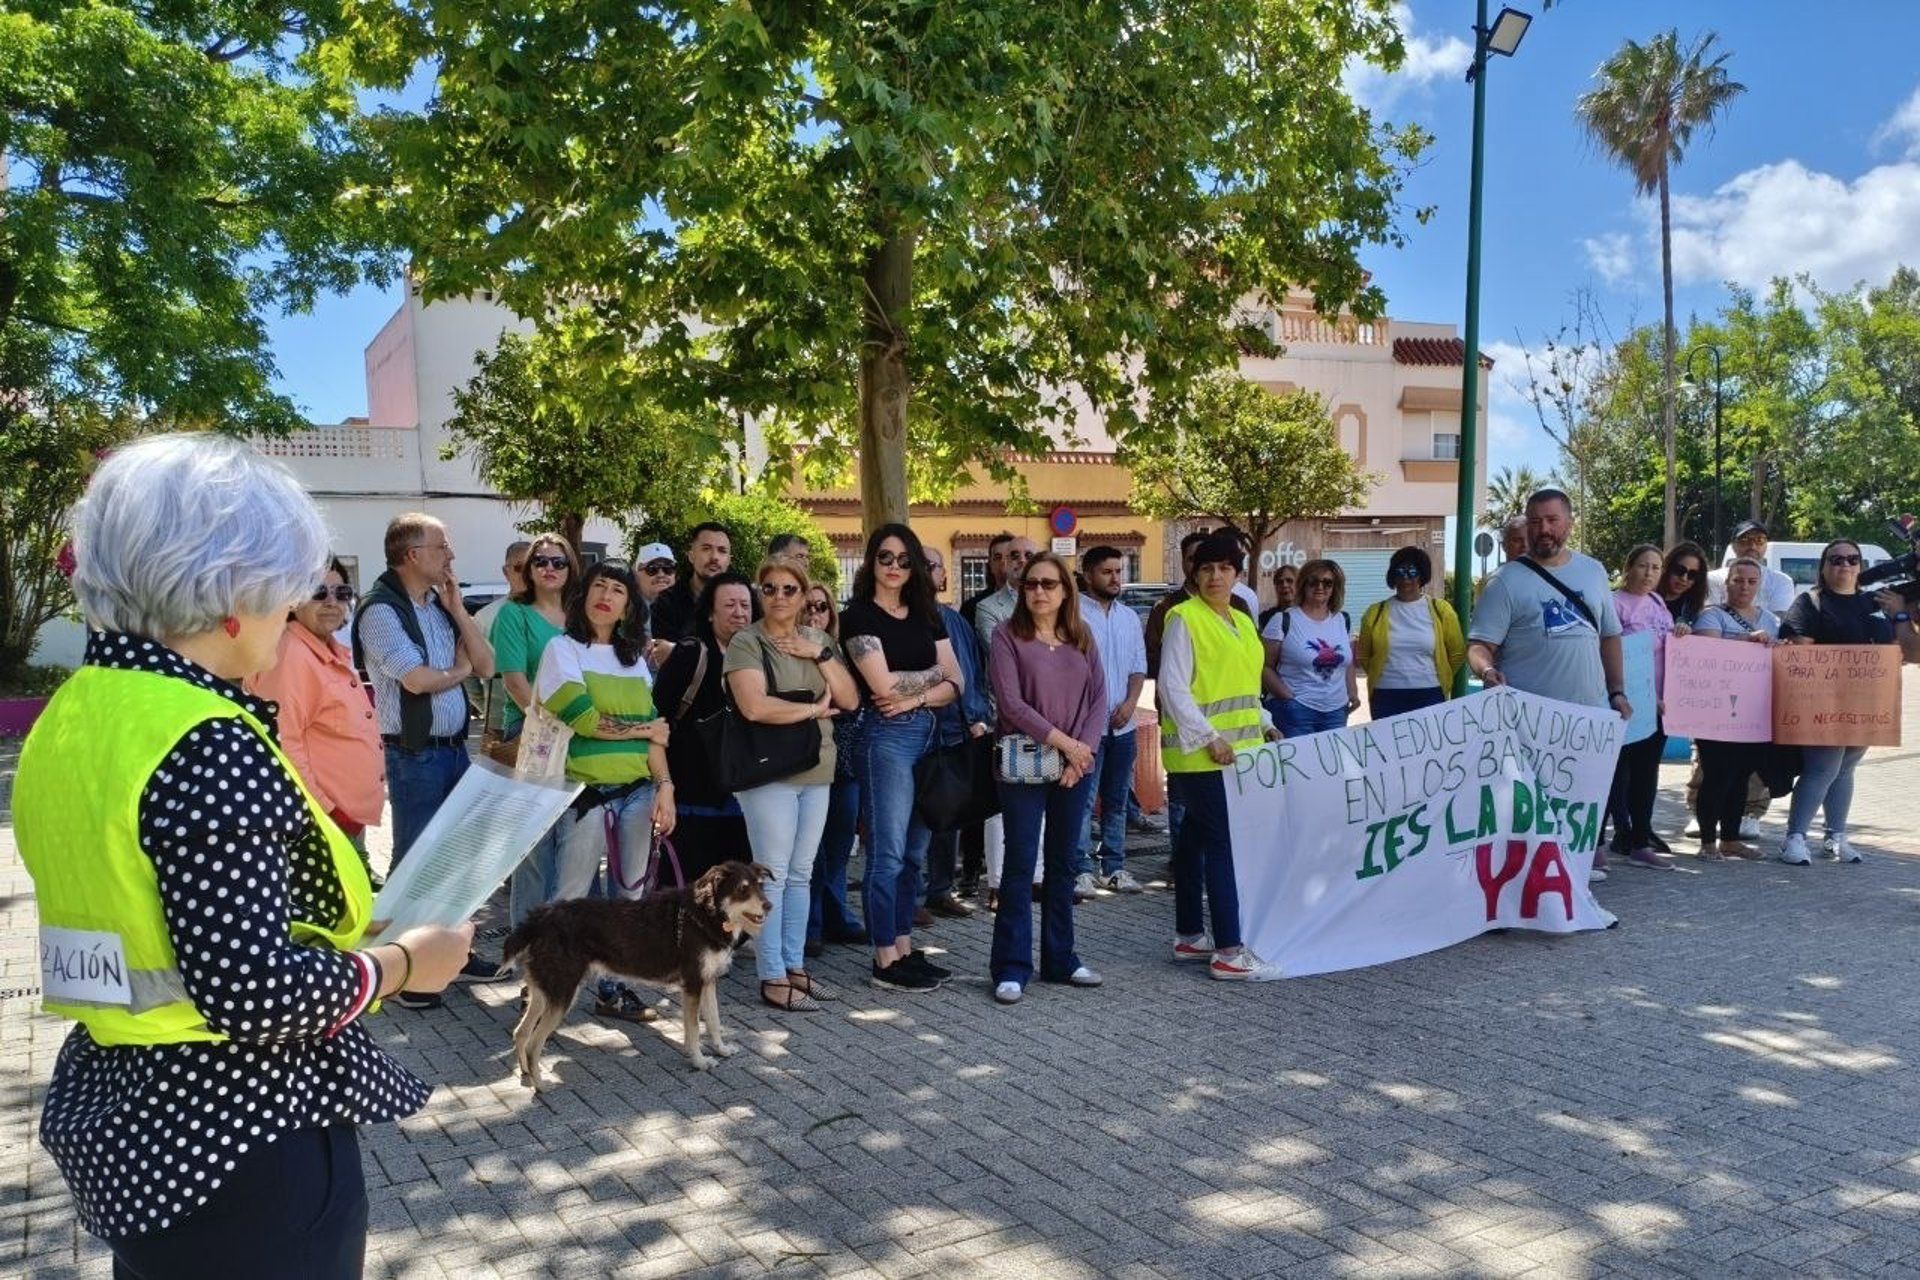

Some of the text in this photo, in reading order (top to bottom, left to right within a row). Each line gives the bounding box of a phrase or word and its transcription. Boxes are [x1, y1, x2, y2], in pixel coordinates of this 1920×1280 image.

[1824, 667, 1839, 680] LA
[1233, 742, 1311, 796] POR
[1313, 727, 1387, 777] UNA
[1549, 711, 1616, 755] DIGNA
[1344, 772, 1386, 825] EN
[1400, 751, 1467, 810] LOS
[1355, 803, 1432, 880] IES
[1445, 784, 1498, 845] LA
[1475, 840, 1574, 922] YA
